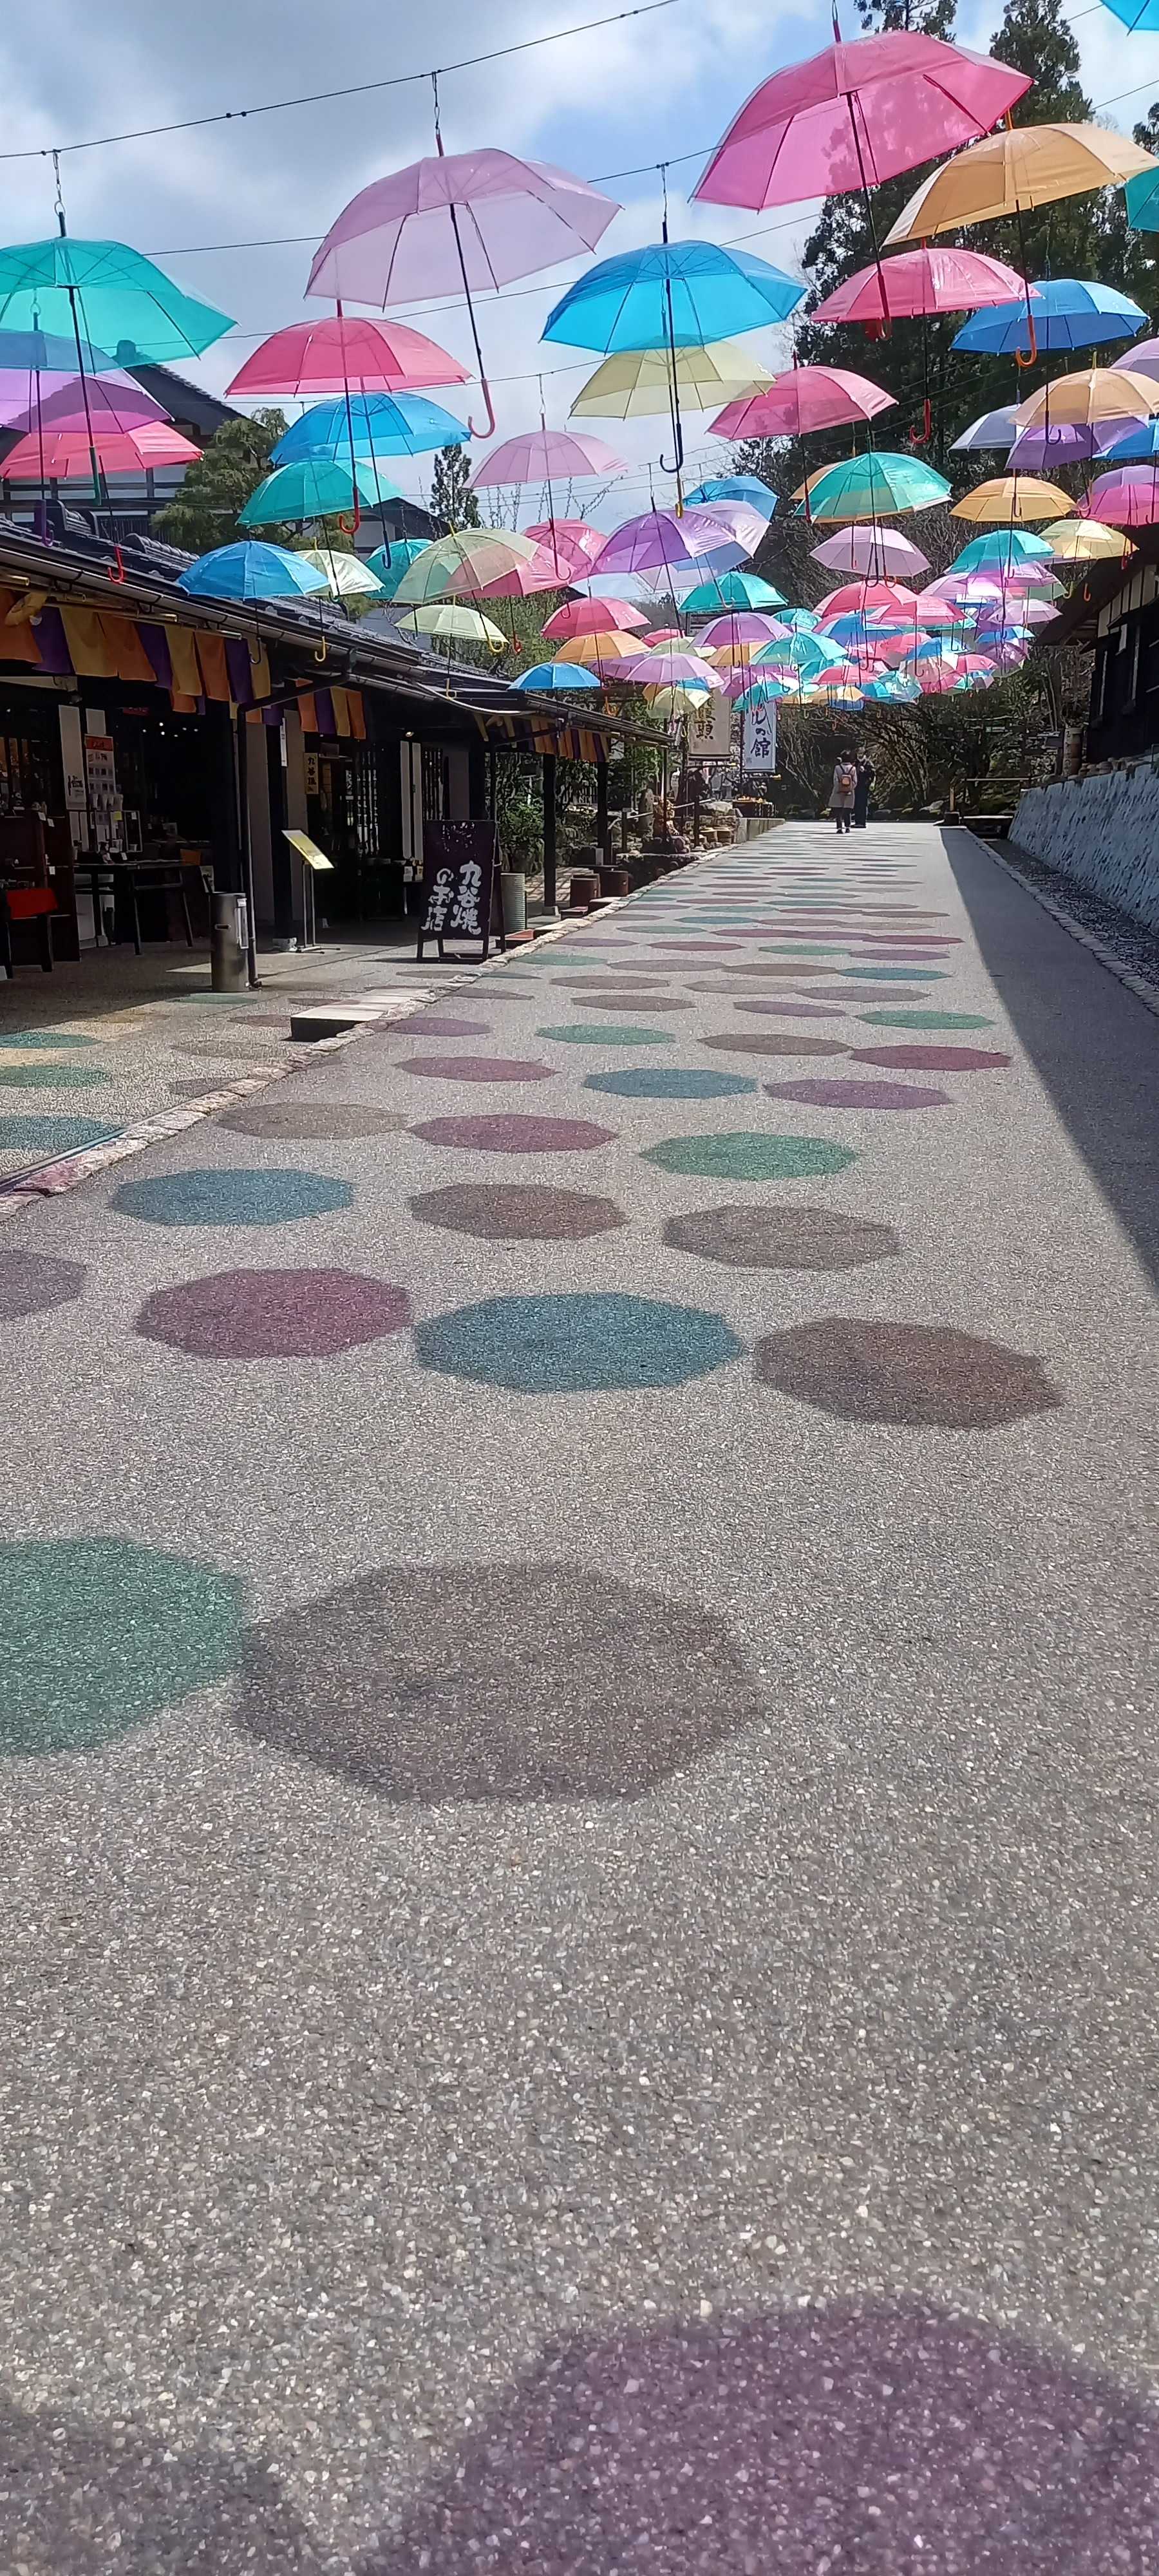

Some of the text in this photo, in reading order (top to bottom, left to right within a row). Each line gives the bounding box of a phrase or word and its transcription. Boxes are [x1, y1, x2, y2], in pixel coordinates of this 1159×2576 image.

[420, 868, 455, 931] のお店
[450, 860, 482, 934] 九谷焼
